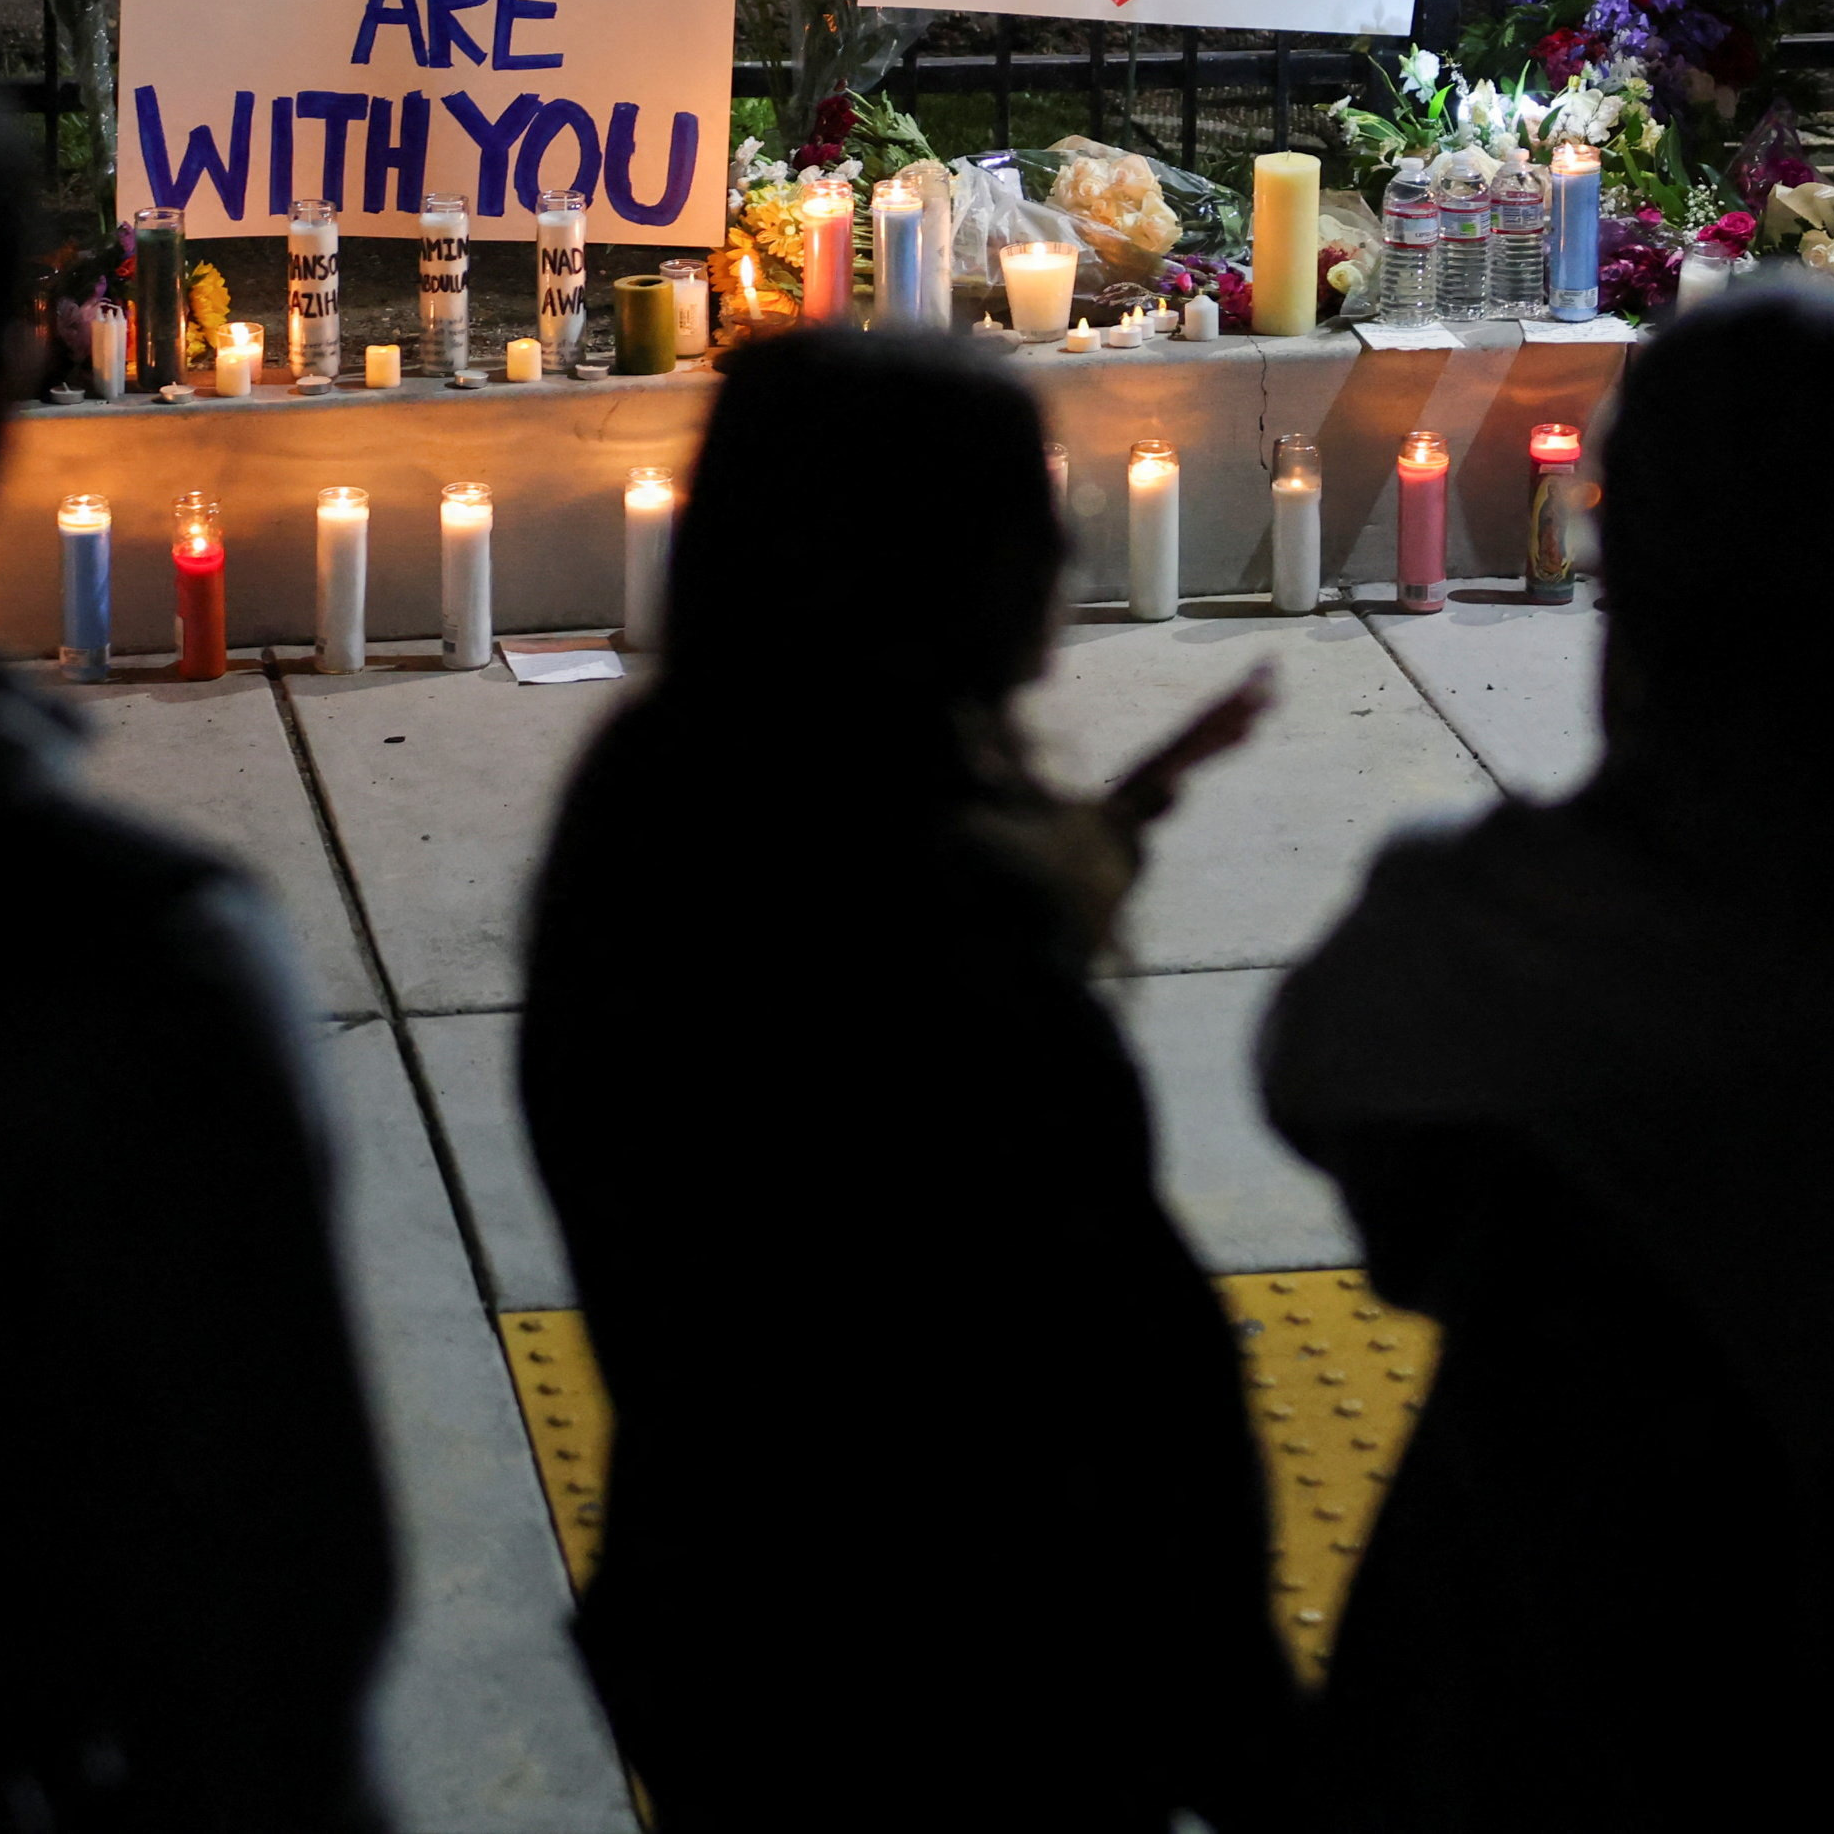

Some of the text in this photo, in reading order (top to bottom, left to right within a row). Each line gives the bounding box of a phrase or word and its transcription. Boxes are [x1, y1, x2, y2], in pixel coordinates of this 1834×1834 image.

[134, 85, 700, 227] WITH YOU
[288, 251, 339, 281] ANSO
[541, 247, 585, 276] NAD
[288, 288, 339, 318] AZIH
[541, 284, 585, 317] AWA
